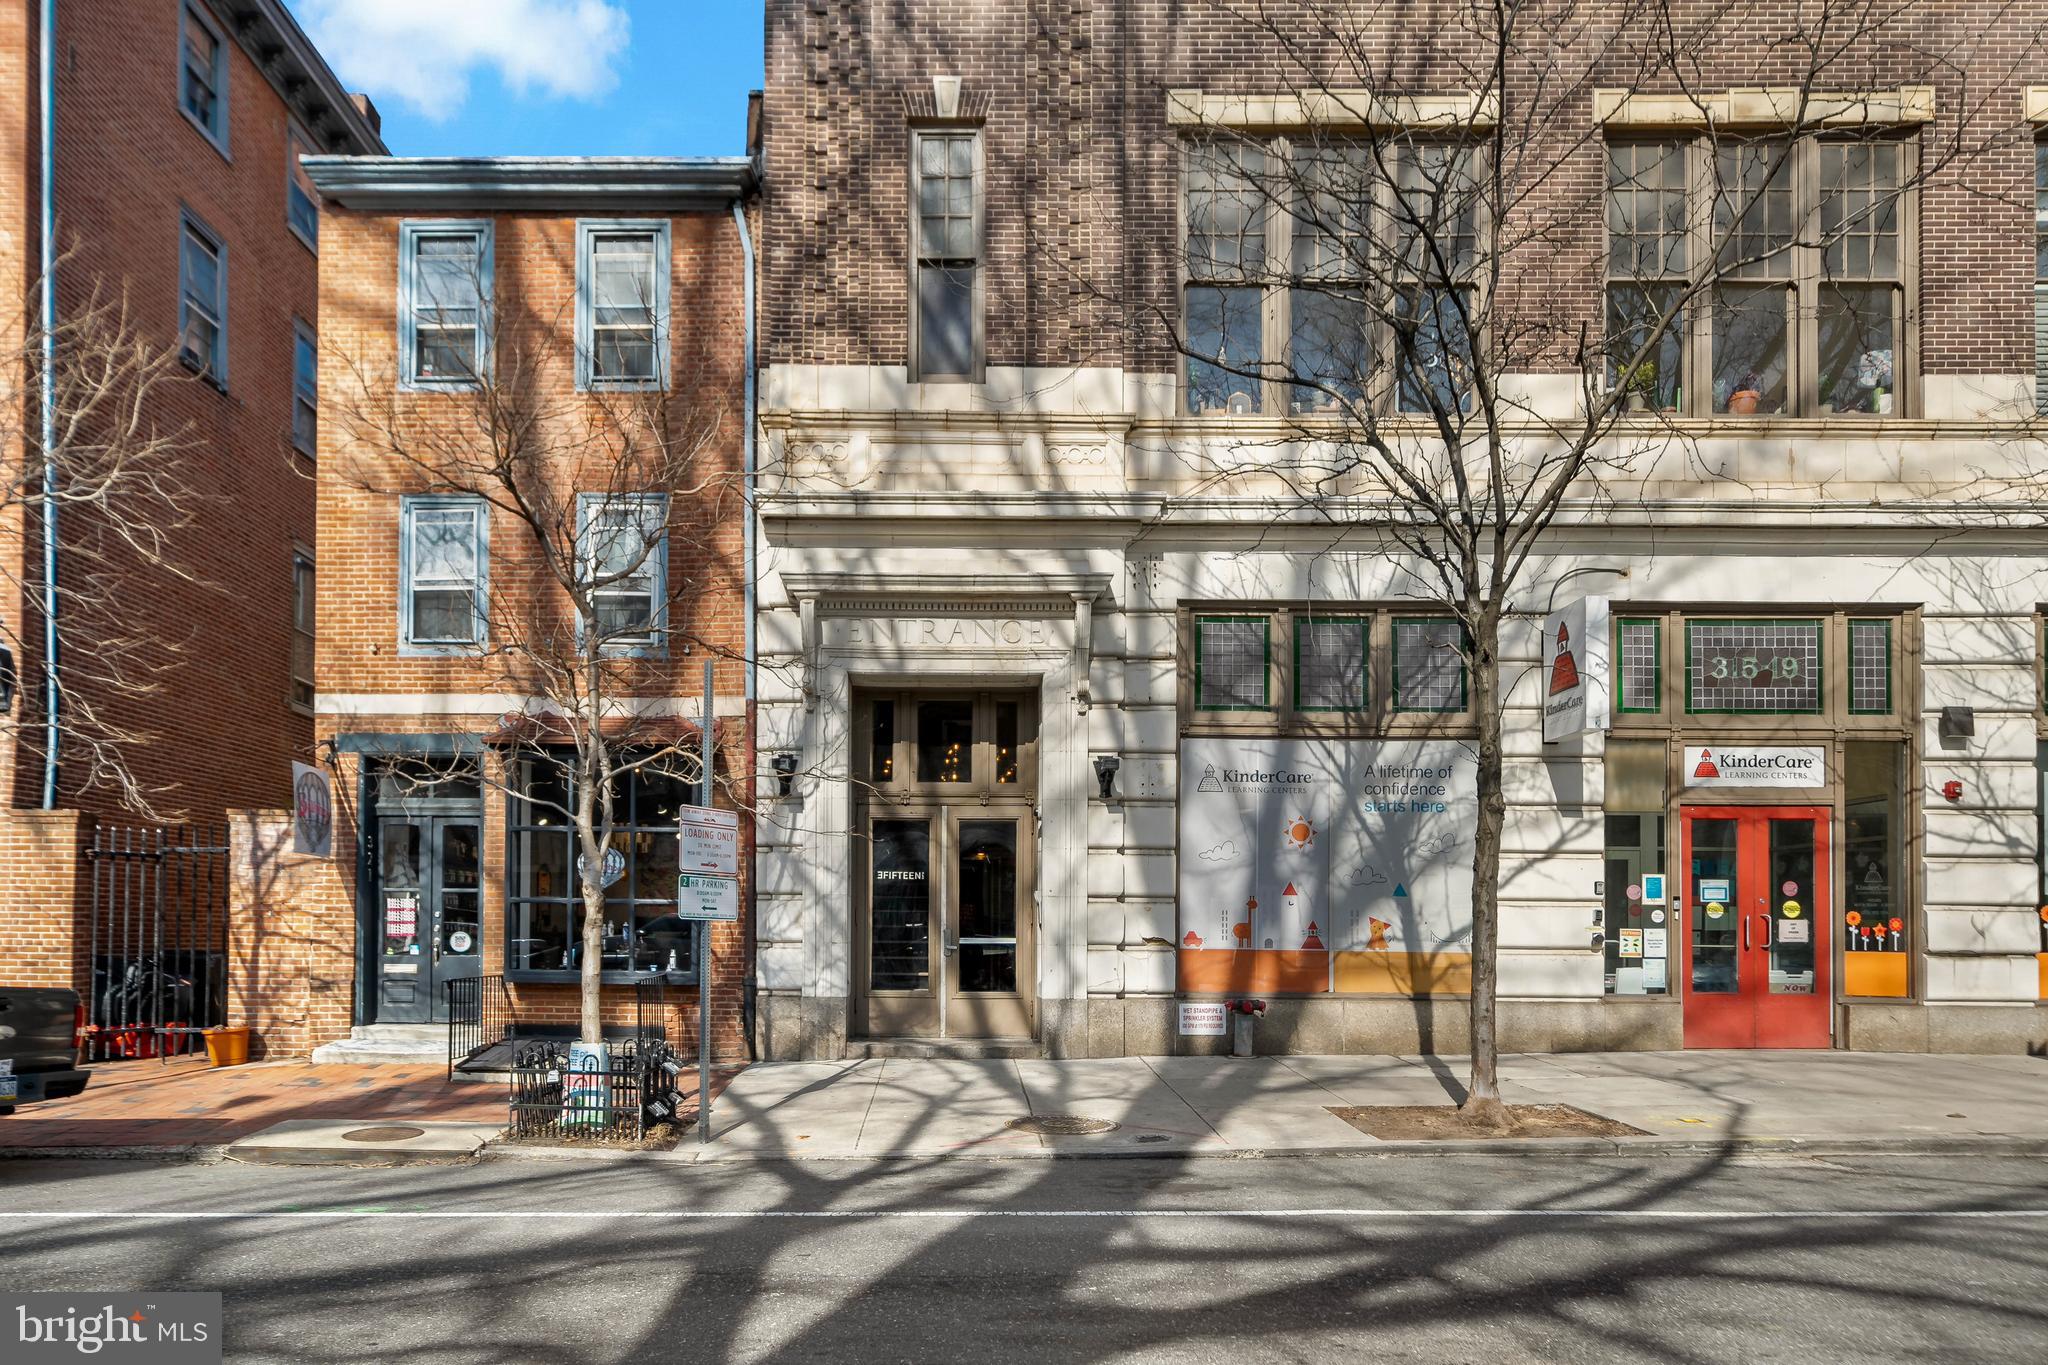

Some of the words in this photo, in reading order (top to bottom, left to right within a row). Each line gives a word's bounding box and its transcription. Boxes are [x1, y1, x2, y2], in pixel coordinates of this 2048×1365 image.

[847, 619, 1046, 644] ENTRANCE
[1711, 656, 1798, 679] 315-19
[1545, 696, 1584, 717] KinderCare
[1720, 754, 1813, 768] KinderCare
[1223, 769, 1312, 783] KinderCare
[1364, 764, 1376, 778] A
[1380, 764, 1433, 778] lifetime
[1438, 765, 1453, 779] of
[1725, 771, 1768, 779] LEARNING
[1227, 786, 1269, 794] LEARNING
[1271, 786, 1307, 794] CENTERS
[1364, 782, 1446, 796] confidence
[1364, 800, 1406, 813] starts
[1411, 800, 1445, 813] here
[684, 828, 714, 840] LOADING
[718, 831, 734, 842] ONLY
[683, 877, 688, 886] 2
[690, 880, 699, 888] HR
[702, 881, 728, 890] PARKING
[1783, 984, 1808, 992] NOW
